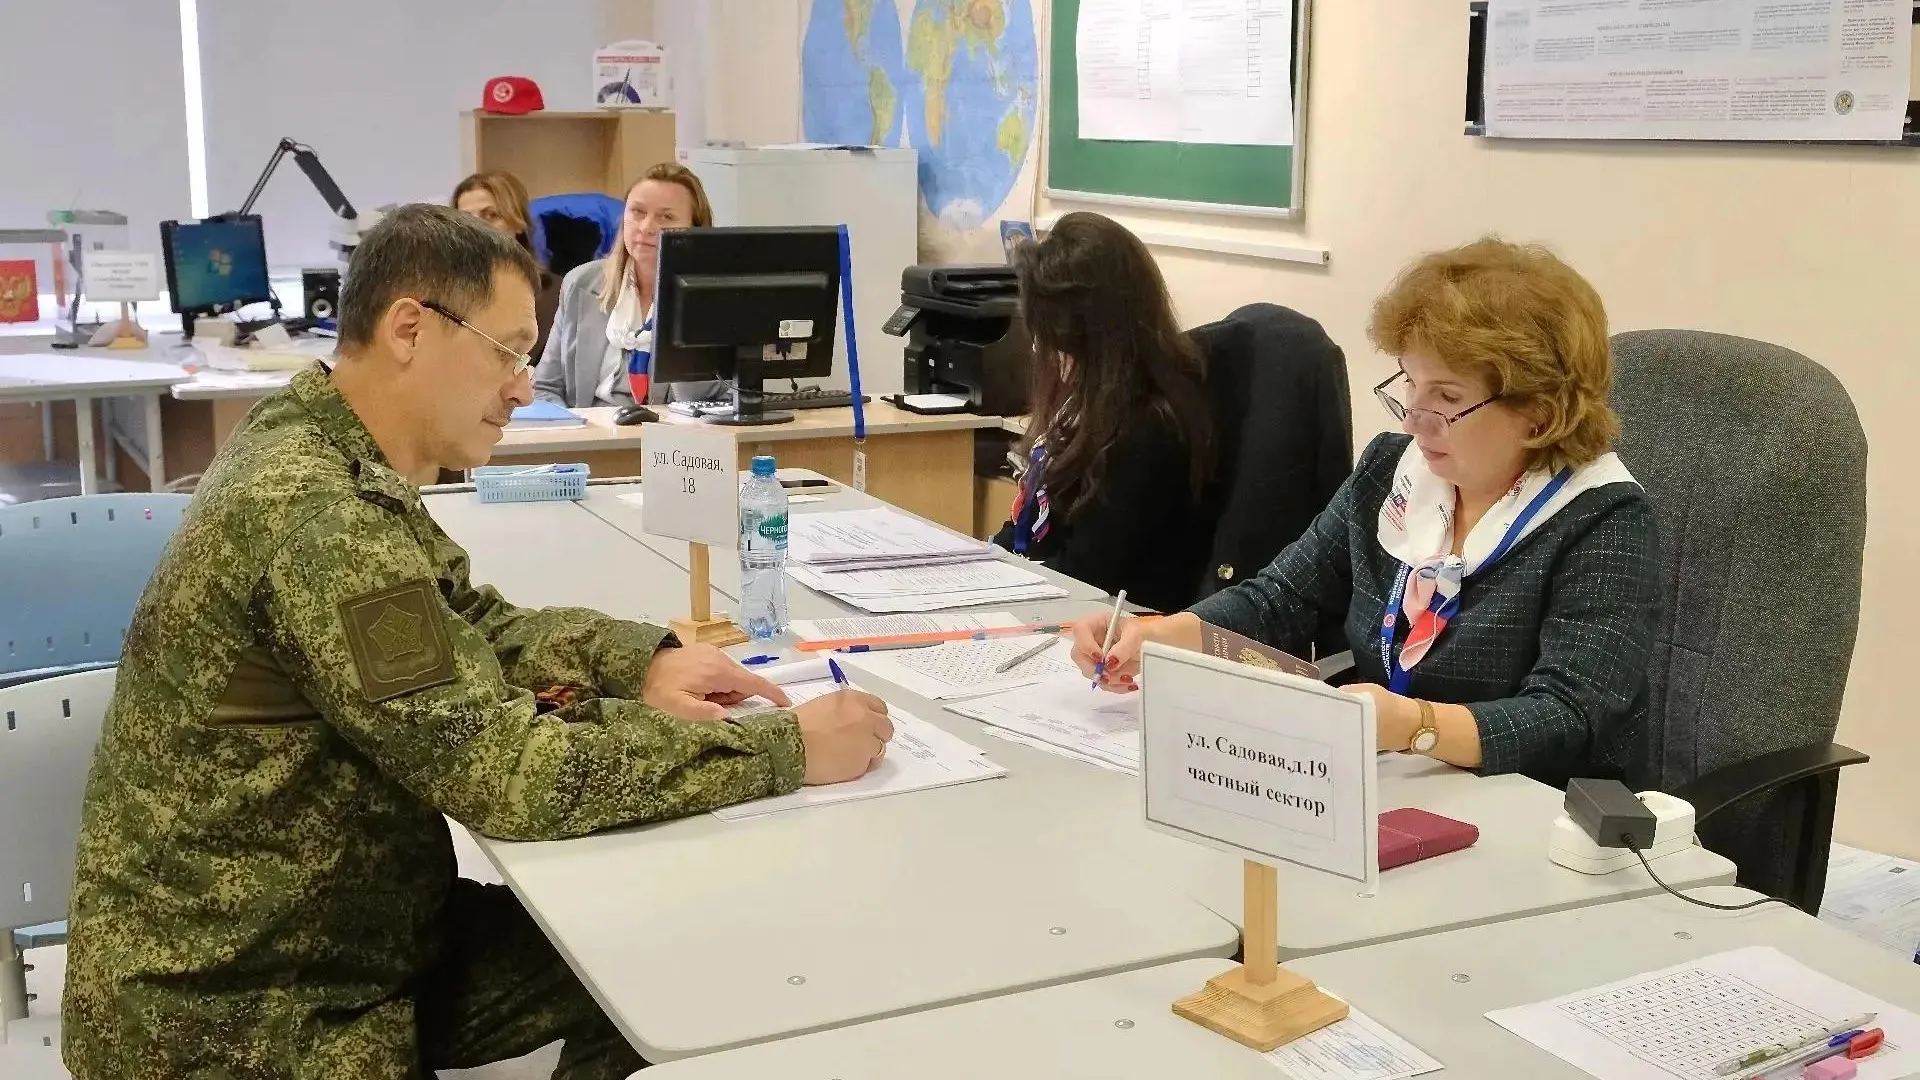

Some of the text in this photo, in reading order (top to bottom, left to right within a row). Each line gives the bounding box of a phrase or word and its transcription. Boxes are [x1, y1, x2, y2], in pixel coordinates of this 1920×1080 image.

[652, 449, 724, 475] ул. Садовая,
[682, 477, 696, 494] 18
[1187, 732, 1210, 749] ул.
[1188, 766, 1325, 817] частный сектор
